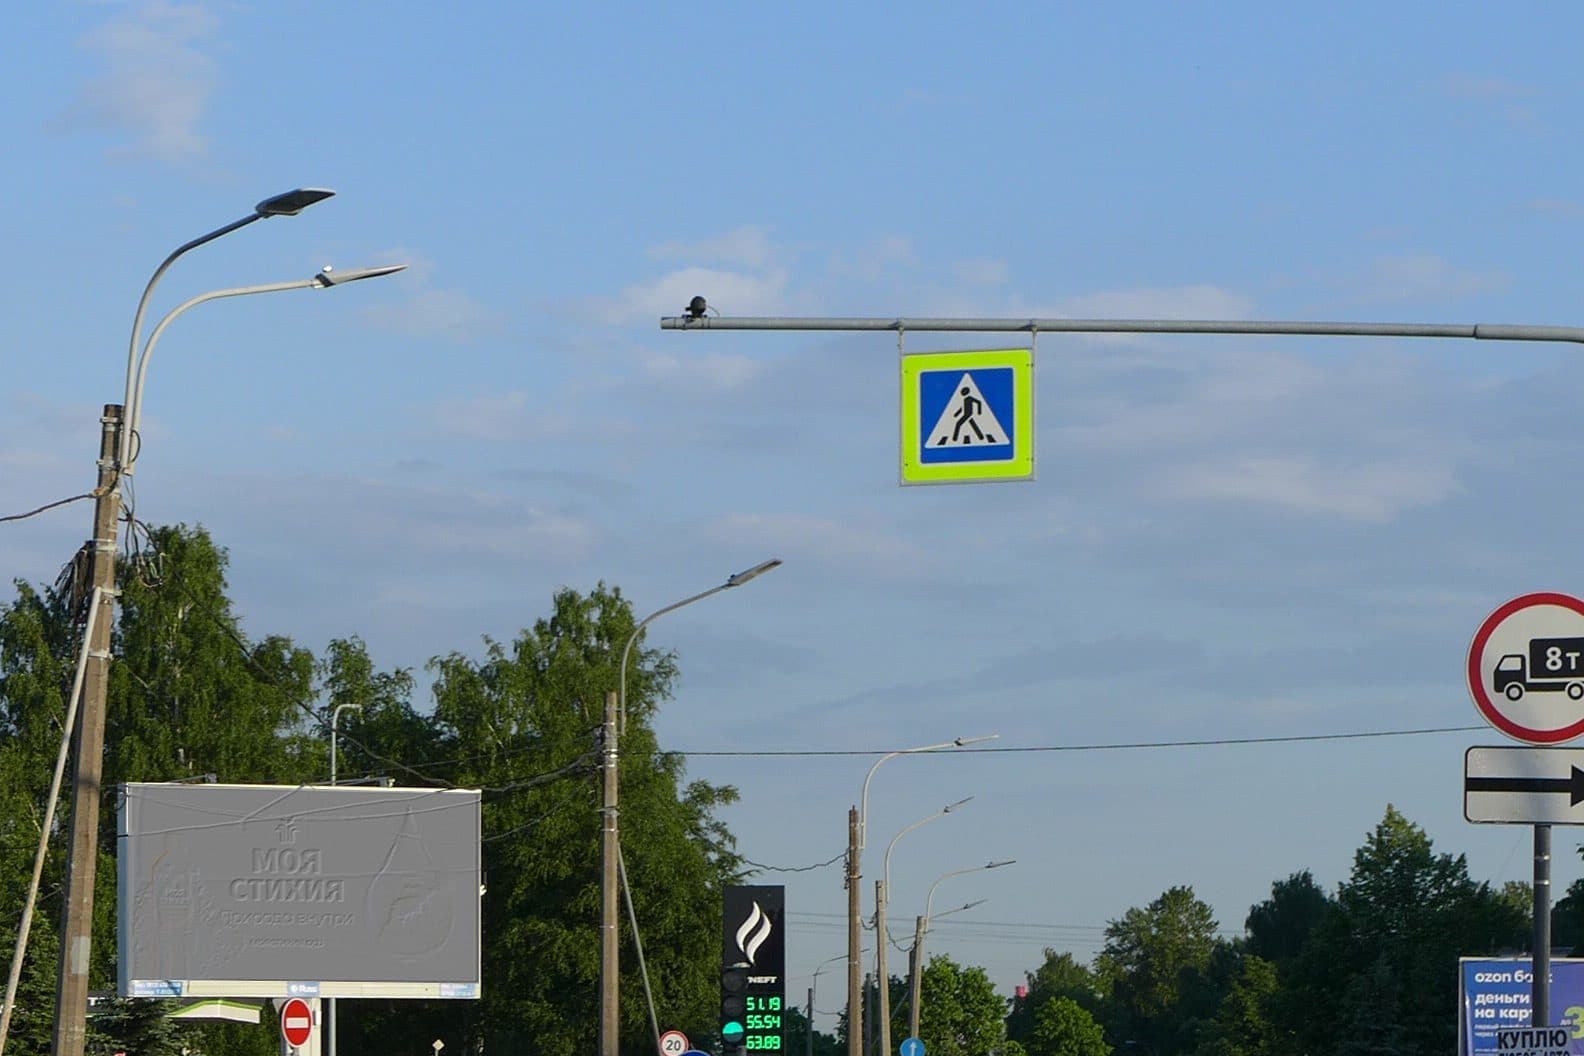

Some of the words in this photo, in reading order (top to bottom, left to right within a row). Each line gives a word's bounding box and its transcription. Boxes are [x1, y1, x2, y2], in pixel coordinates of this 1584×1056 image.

[251, 847, 322, 874] МОЯ
[230, 878, 345, 903] СТИХИЯ
[1474, 972, 1512, 983] ozon
[747, 997, 781, 1011] 51.19
[1474, 993, 1531, 1006] деньги
[1474, 1008, 1495, 1019] на
[1499, 1008, 1533, 1021] кар
[747, 1015, 781, 1029] 55.54
[666, 1038, 681, 1051] 20
[746, 1035, 781, 1049] 63.89
[1498, 1029, 1568, 1050] КУПЛЮ
